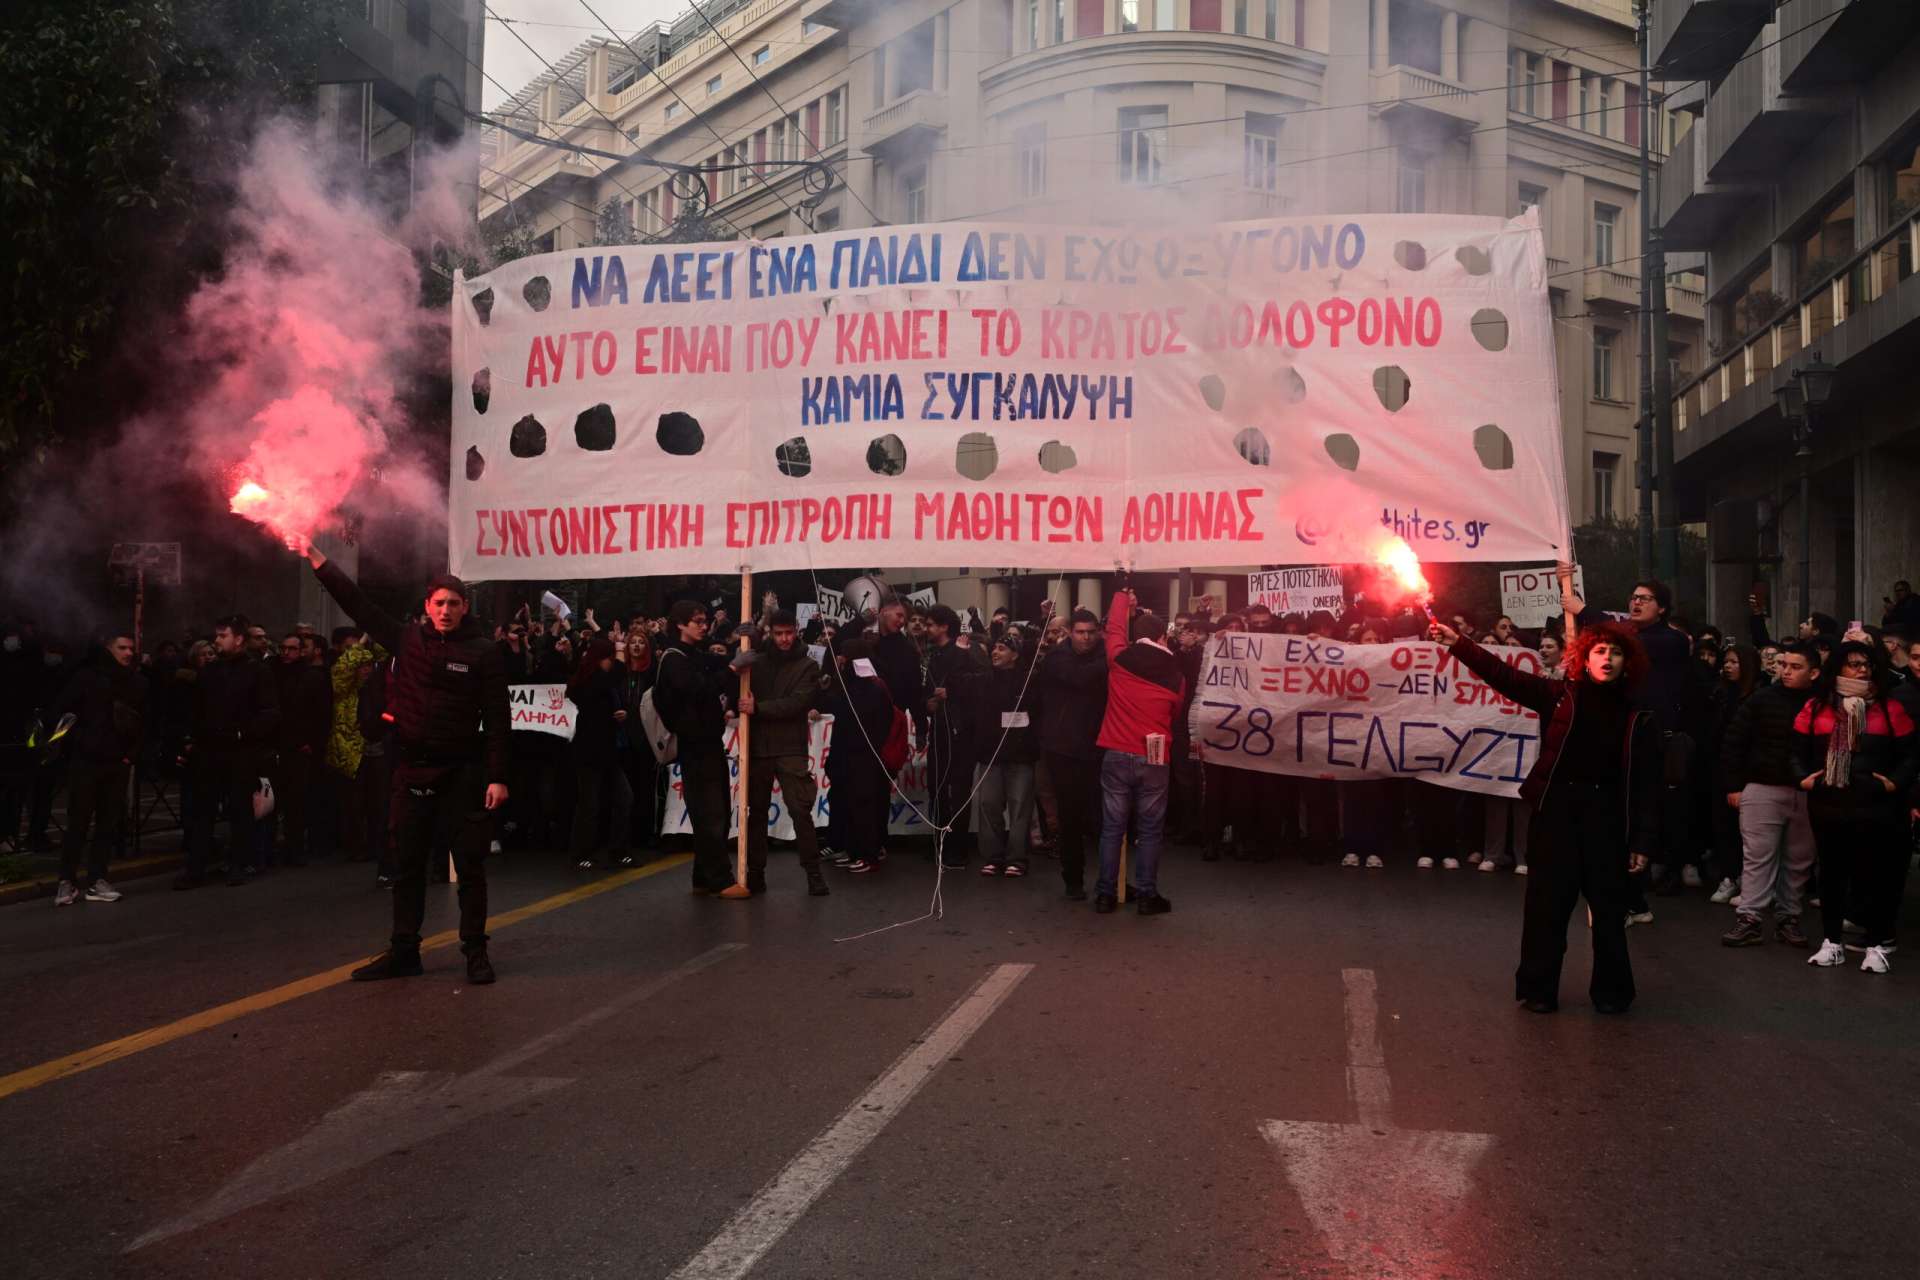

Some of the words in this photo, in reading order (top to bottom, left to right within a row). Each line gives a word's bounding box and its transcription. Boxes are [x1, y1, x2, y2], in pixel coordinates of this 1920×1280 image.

[571, 256, 629, 308] ΝΑ
[643, 252, 737, 304] ΛΕΕΙ
[748, 244, 817, 298] ΕΝΑ
[830, 233, 941, 289] ΠΑΙΔΙ
[956, 231, 1046, 283] ΔΕΝ
[525, 330, 619, 389] ΑΥΤΟ
[635, 324, 732, 376] ΕΙΝΑΙ
[746, 316, 821, 373] ΠΟΥ
[835, 309, 948, 365] ΚΑΝΕΙ
[971, 307, 1022, 358] ΤΟ
[1041, 306, 1188, 359] ΚΡΑΤΟΣ
[801, 373, 905, 426] ΚΑΜΙΑ
[920, 371, 1133, 421] ΣΥΓΚΑΛΥΨΗ
[475, 502, 704, 558] ΣΥΝΤΟΝΙΣΤΙΚΗ
[726, 494, 891, 549] ΕΠΙΤΡΟΠΗ
[914, 491, 1103, 544] ΜΑΘΗΤΩΝ
[1120, 488, 1264, 544] ΑΘΗΝΑΣ
[1504, 570, 1577, 592] ΠΟΤ
[1213, 636, 1263, 662] ΔΕΝ
[1206, 665, 1249, 691] ΔΕΝ
[511, 708, 569, 728] ΛΗΜΑ
[1202, 701, 1275, 757] 38
